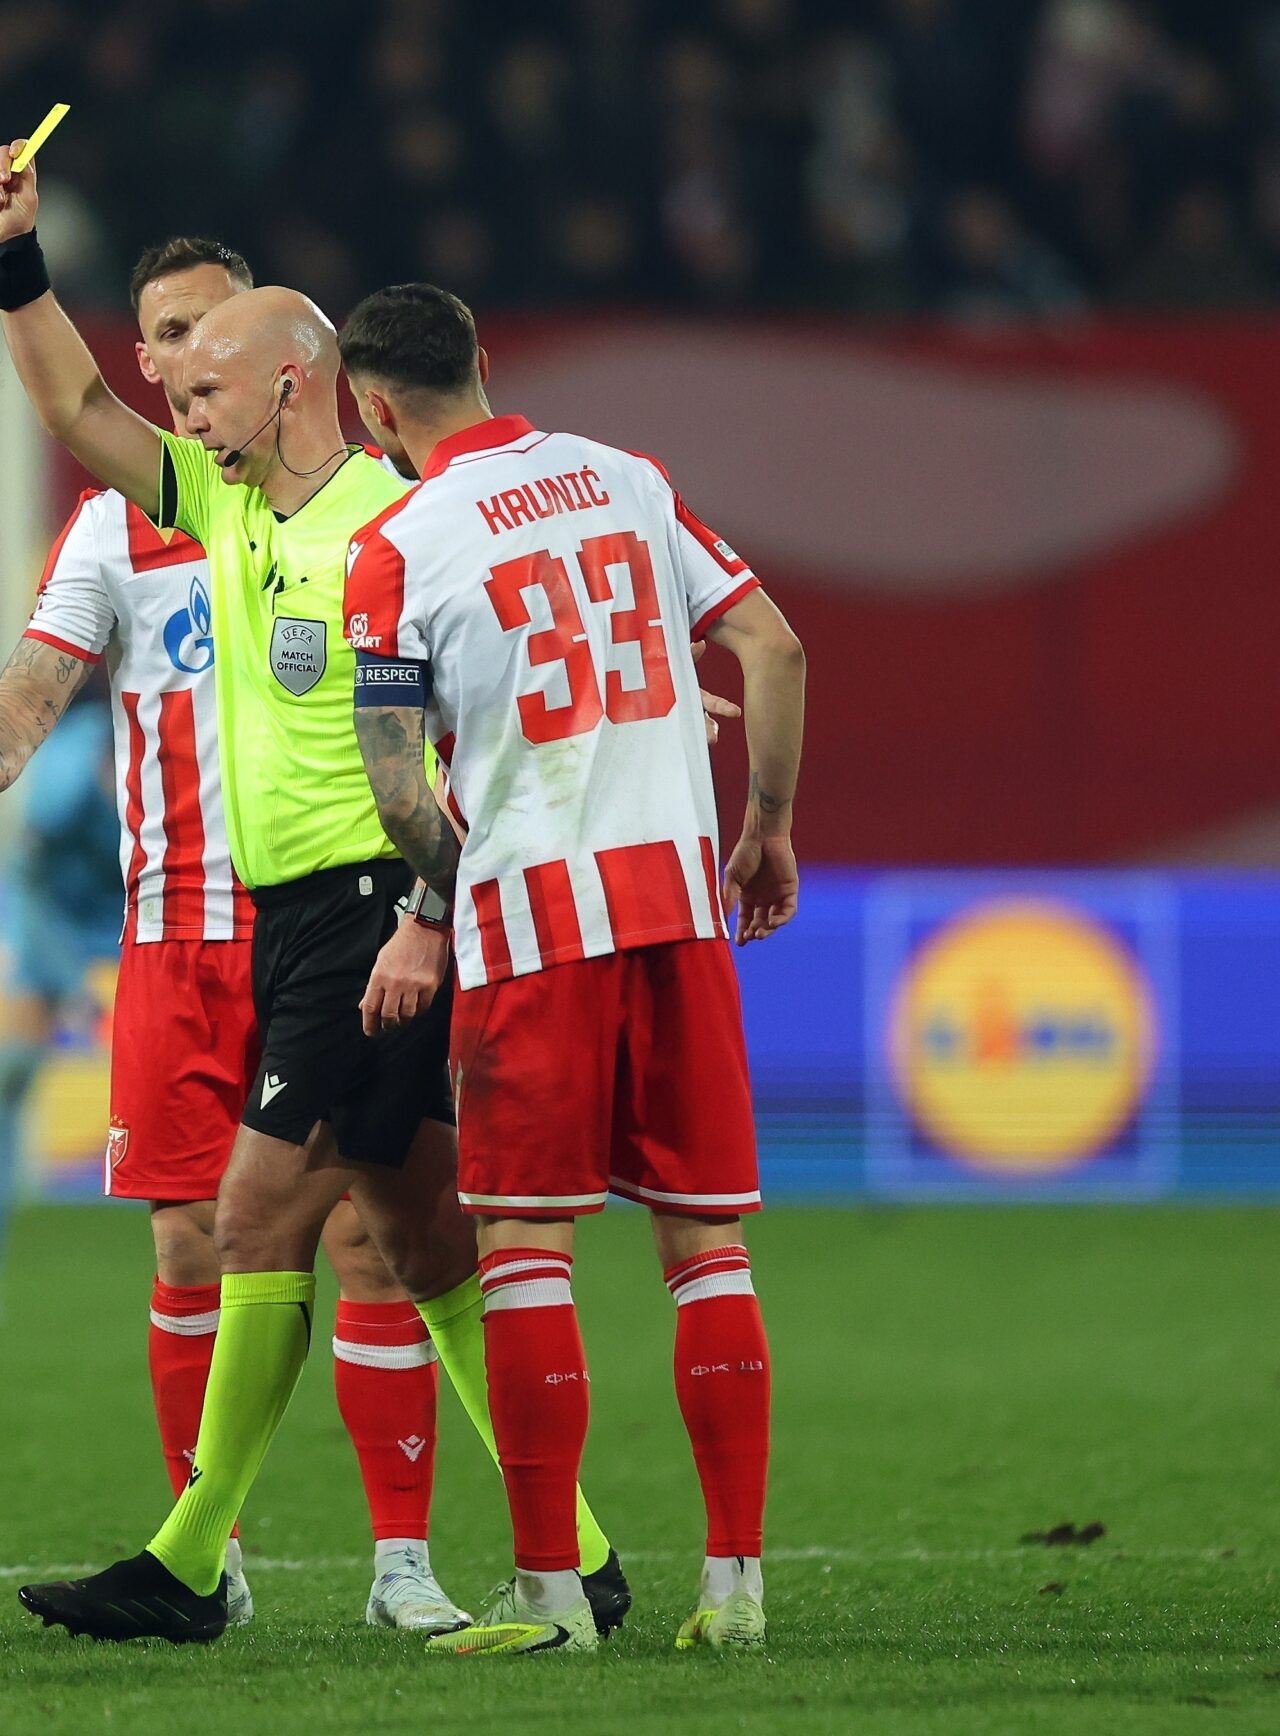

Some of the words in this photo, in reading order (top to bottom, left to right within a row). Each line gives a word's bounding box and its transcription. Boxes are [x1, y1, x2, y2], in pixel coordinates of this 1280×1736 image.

[476, 465, 610, 535] KRUNIĆ
[283, 628, 313, 643] UEFA
[483, 531, 676, 744] 33
[281, 650, 313, 661] MATCH
[277, 662, 317, 673] OFFICIAL
[366, 668, 419, 681] RESPECT
